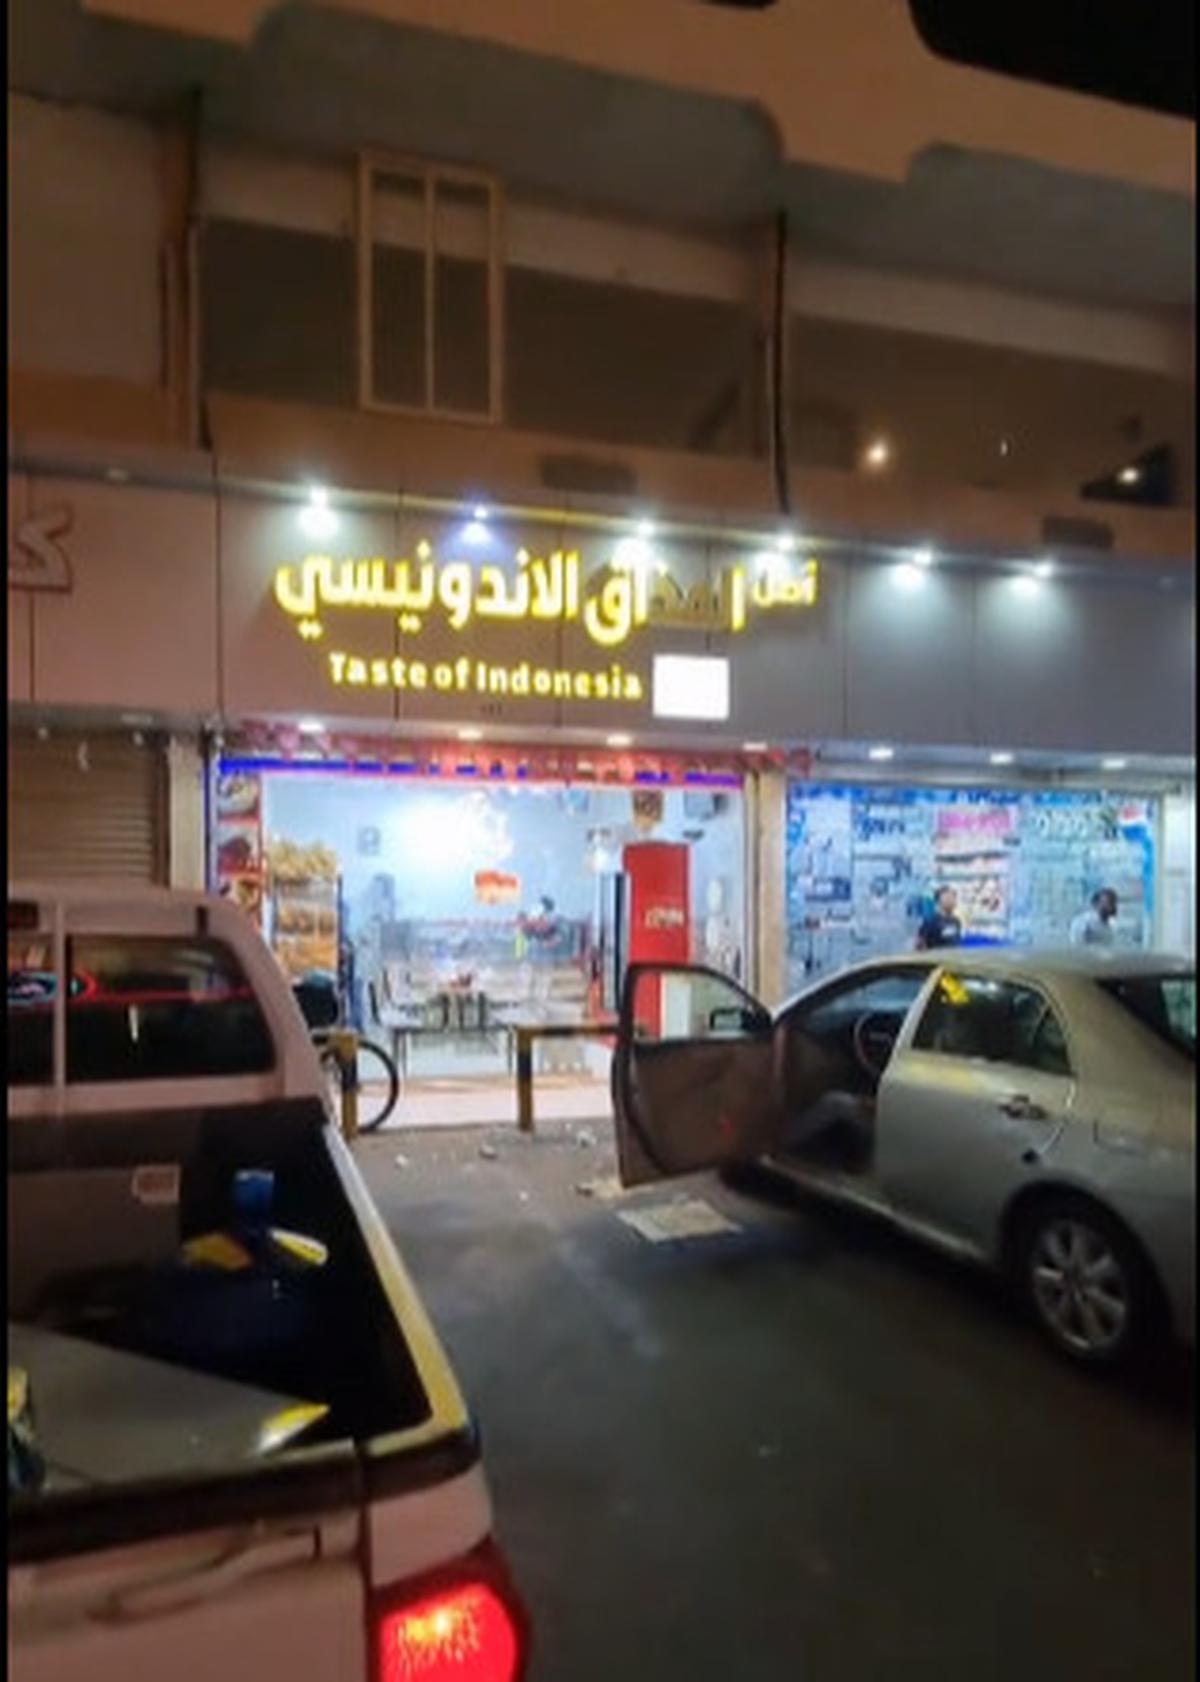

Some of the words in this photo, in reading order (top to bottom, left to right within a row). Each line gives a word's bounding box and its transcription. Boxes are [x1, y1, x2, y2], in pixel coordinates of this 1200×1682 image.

[329, 652, 428, 689] Taste
[433, 657, 471, 692] of
[476, 662, 643, 700] Indonesia
